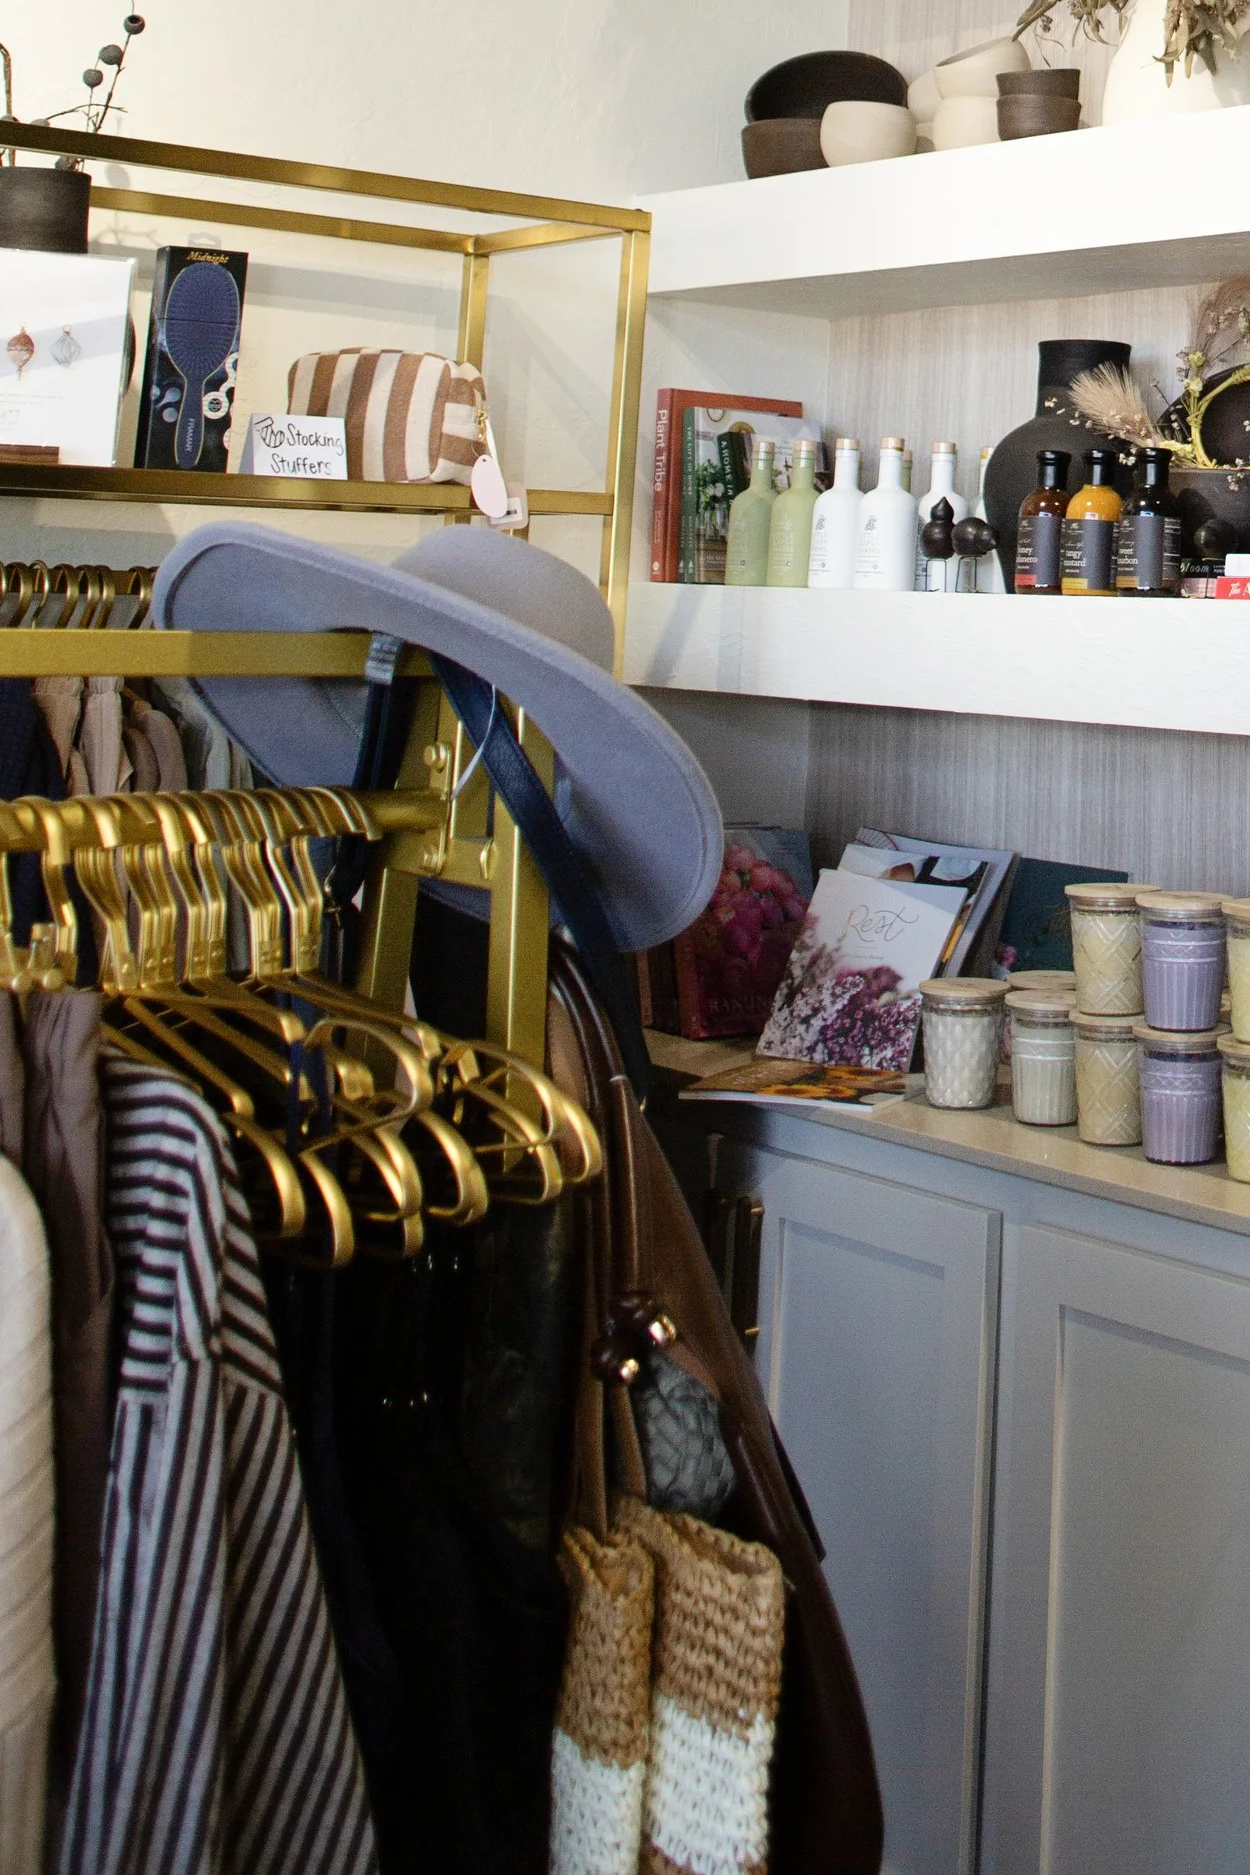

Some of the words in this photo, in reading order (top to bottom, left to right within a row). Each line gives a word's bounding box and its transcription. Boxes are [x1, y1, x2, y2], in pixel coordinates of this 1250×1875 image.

[186, 251, 230, 266] Midnight
[185, 417, 195, 453] FRAMAR
[286, 423, 345, 456] Stocking
[655, 409, 669, 449] Plant
[270, 453, 332, 476] Stuffers
[654, 451, 668, 492] Tribe
[721, 448, 733, 482] HOME
[1228, 581, 1241, 597] The
[846, 904, 920, 942] Rest
